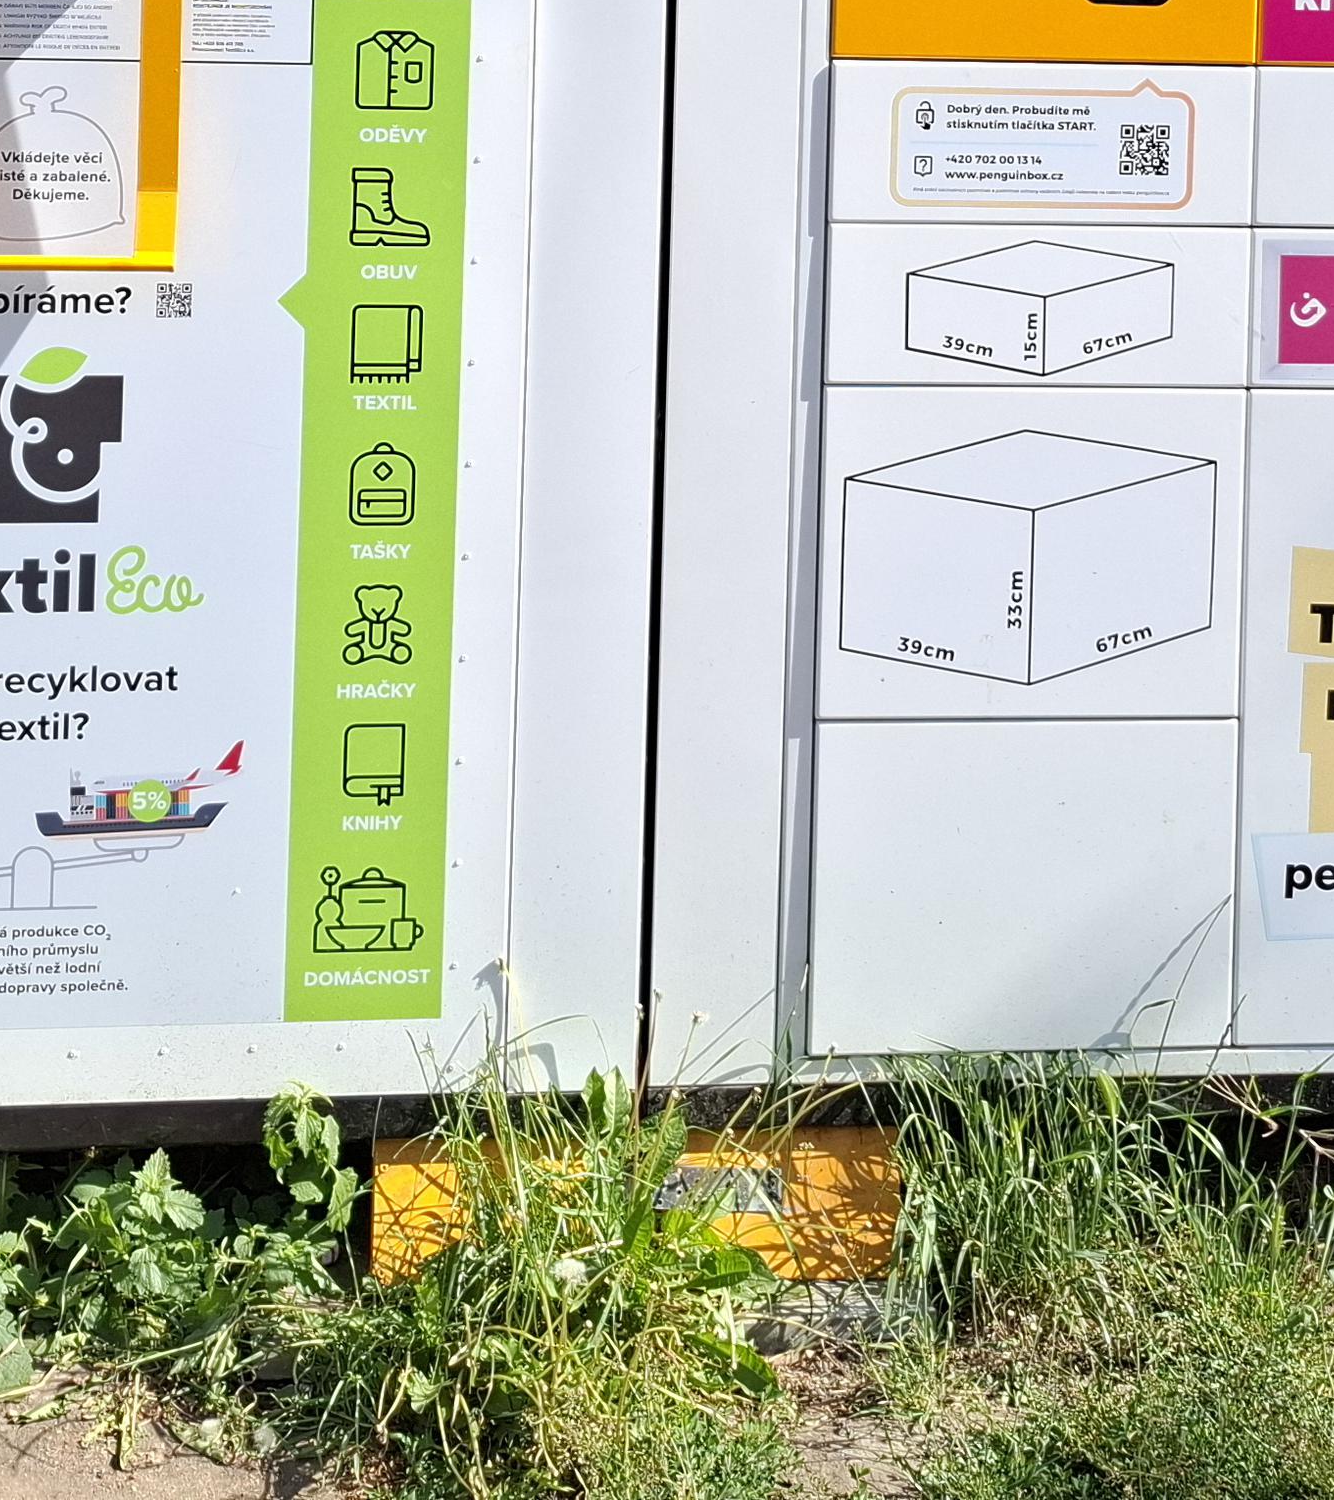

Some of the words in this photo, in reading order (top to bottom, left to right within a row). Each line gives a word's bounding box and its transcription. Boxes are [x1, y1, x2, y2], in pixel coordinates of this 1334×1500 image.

[947, 105, 981, 116] Dobrý
[984, 105, 1009, 115] den.
[1012, 105, 1069, 115] Probudíte
[1072, 106, 1090, 116] mě
[359, 125, 426, 143] ODĚVY
[947, 120, 1008, 130] stisknutím
[1011, 120, 1054, 131] tlačítka
[1057, 122, 1096, 131] START.
[1, 150, 69, 165] Vkládejte
[73, 150, 103, 164] věci
[946, 155, 973, 164] +420
[975, 155, 997, 164] 702
[999, 155, 1014, 165] 00
[1017, 156, 1028, 165] 13
[1030, 156, 1042, 165] 14
[30, 173, 38, 183] a
[43, 169, 111, 183] zabalené.
[945, 170, 1064, 182] www.penguinbox.cz
[13, 186, 89, 203] Děkujeme.
[360, 264, 417, 280] OBUV
[1024, 313, 1039, 361] 15cm
[1082, 330, 1133, 357] 67cm
[942, 335, 994, 358] 39cm
[353, 394, 417, 411] TEXTIL
[350, 540, 411, 559] TAŠKY
[1007, 568, 1024, 629] 33cm
[1095, 623, 1153, 653] 67cm
[897, 636, 956, 661] 39cm
[336, 680, 416, 699] HRAČKY
[132, 790, 167, 811] 5%
[341, 813, 402, 830] KNIHY
[11, 924, 79, 941] produkce
[32, 942, 98, 959] průmyslu
[35, 961, 60, 974] než
[65, 960, 101, 973] lodní
[303, 965, 430, 987] DOMÁCNOST
[61, 979, 128, 996] společně.
